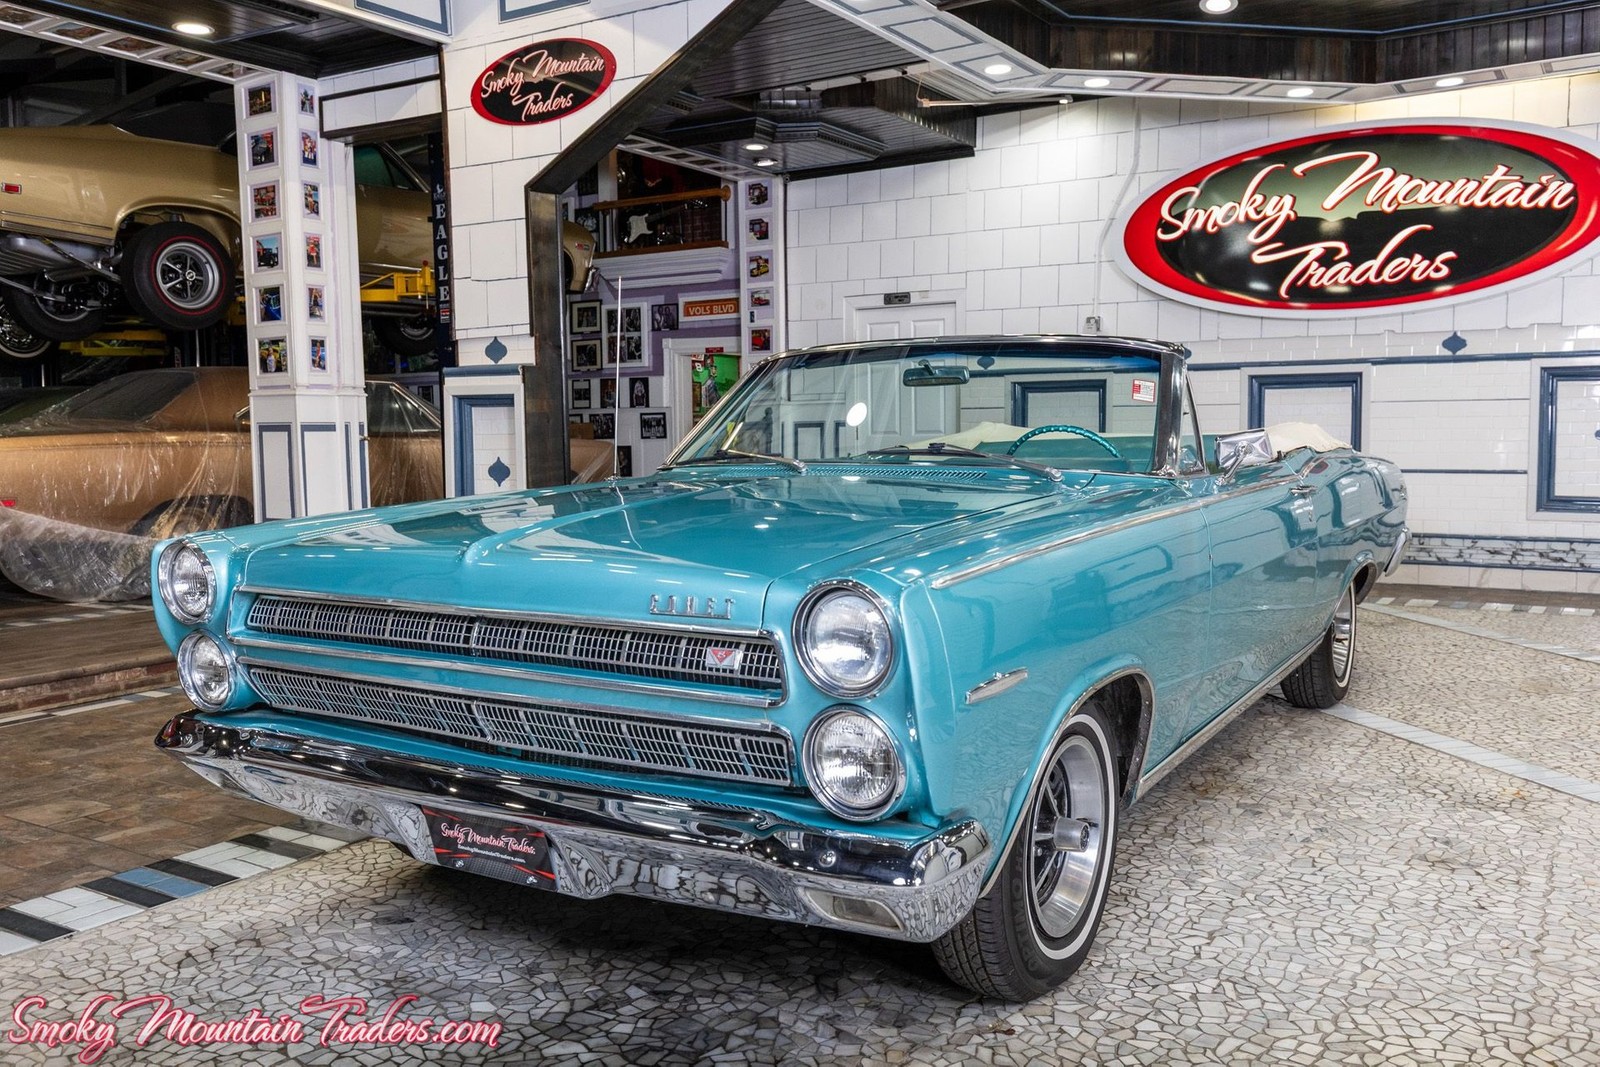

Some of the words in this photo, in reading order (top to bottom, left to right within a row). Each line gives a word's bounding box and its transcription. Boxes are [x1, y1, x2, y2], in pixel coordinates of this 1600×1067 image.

[480, 57, 525, 98] Smoky
[522, 49, 605, 78] Mountain
[511, 81, 575, 122] Traders
[1156, 163, 1297, 244] Smoky
[1293, 150, 1579, 214] Mountain
[435, 203, 450, 301] EAGLE
[1250, 224, 1459, 299] Traders
[688, 305, 711, 316] VOLS
[712, 304, 735, 314] BLVD
[650, 594, 735, 620] COMET
[441, 822, 466, 843] Smoky
[460, 827, 506, 849] Mountain
